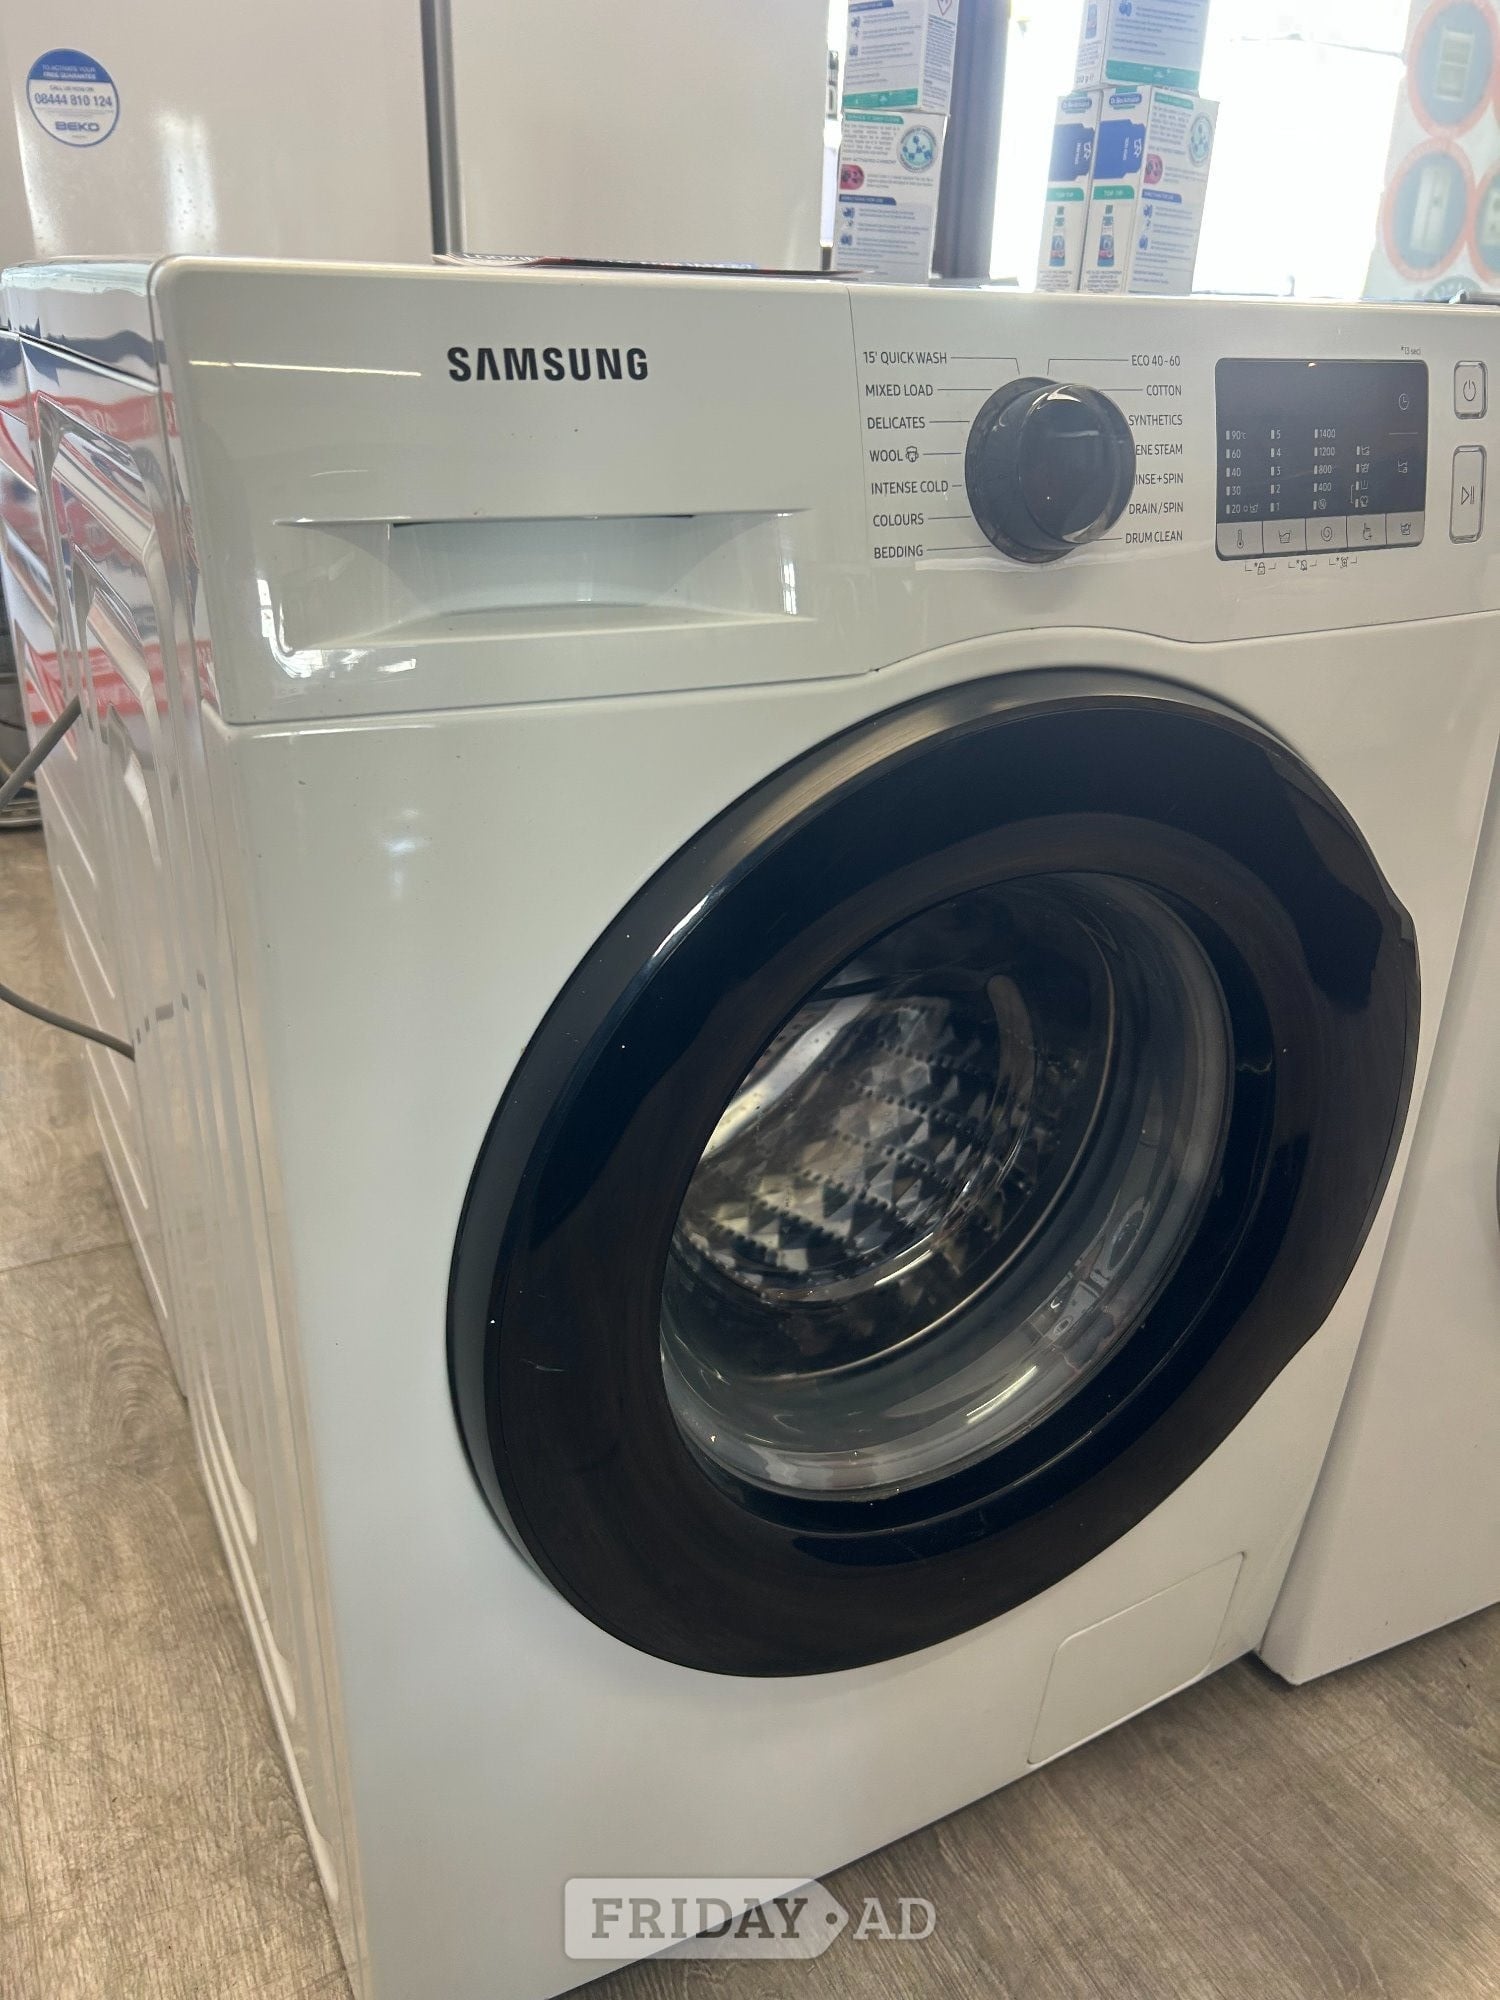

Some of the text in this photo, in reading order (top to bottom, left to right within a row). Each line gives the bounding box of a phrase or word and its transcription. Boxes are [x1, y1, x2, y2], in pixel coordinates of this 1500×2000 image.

[34, 92, 112, 107] 08444 810 124
[55, 121, 100, 132] BEKO
[446, 346, 649, 382] SAMSUNG
[863, 351, 947, 365] 15' QUICK WASH
[1131, 354, 1150, 367] ECO
[865, 384, 934, 397] MIXED LOAD
[1146, 384, 1182, 396] COTTON
[867, 416, 926, 430] DELICATES
[1128, 414, 1183, 426] SYNTHETICS
[1275, 429, 1281, 439] 5
[1319, 428, 1336, 439] 1400
[869, 449, 904, 462] WOOL
[1154, 443, 1183, 456] STEAM
[1231, 449, 1241, 459] 60
[1275, 447, 1281, 457] 4
[1319, 446, 1336, 456] 1200
[1231, 467, 1241, 477] 40
[1275, 466, 1281, 476] 3
[1318, 464, 1332, 474] 800
[1135, 473, 1184, 485] INSE+SPIN
[871, 480, 949, 495] INTENSE COLD
[1231, 485, 1241, 496] 30
[1275, 484, 1281, 494] 2
[1231, 504, 1241, 514] 20
[873, 512, 924, 527] COLOURS
[1125, 530, 1183, 544] DRUM CLEAN
[874, 544, 924, 559] BEDDING
